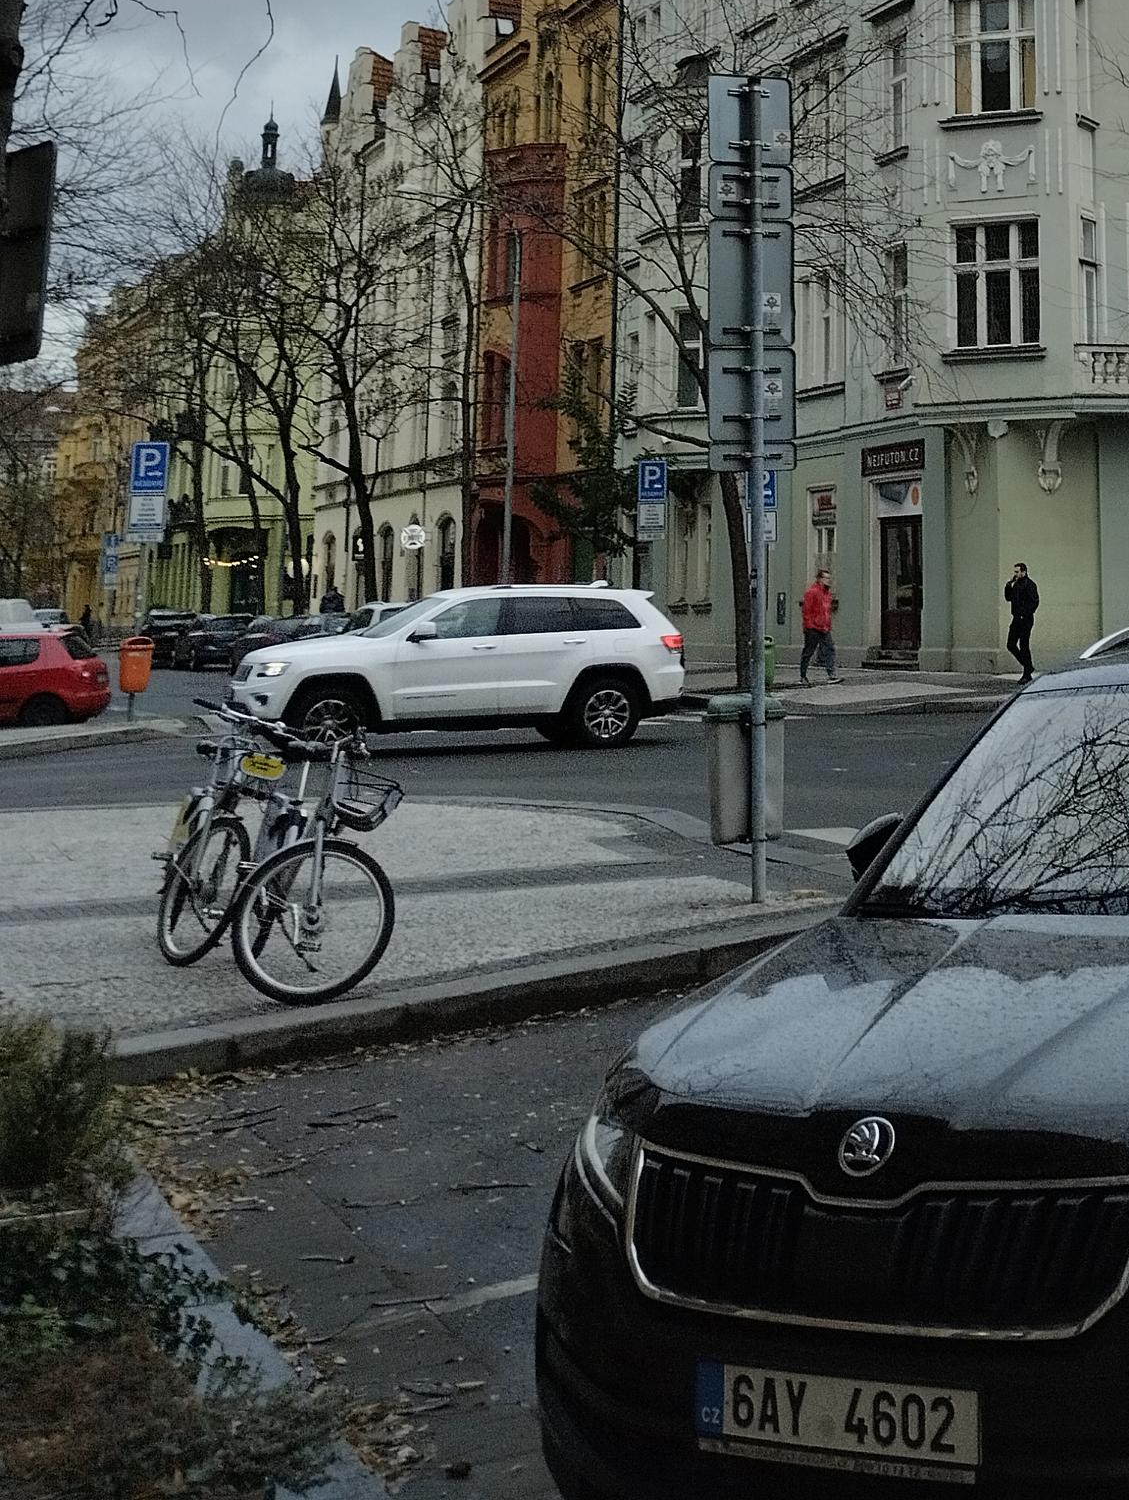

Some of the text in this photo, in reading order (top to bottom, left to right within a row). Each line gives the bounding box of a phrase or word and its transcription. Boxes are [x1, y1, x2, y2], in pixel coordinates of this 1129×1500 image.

[139, 448, 161, 477] P
[866, 448, 919, 468] NEJFUTON.CZ
[644, 466, 660, 488] P
[701, 1406, 720, 1425] CZ
[732, 1374, 956, 1454] 6AY 4602
